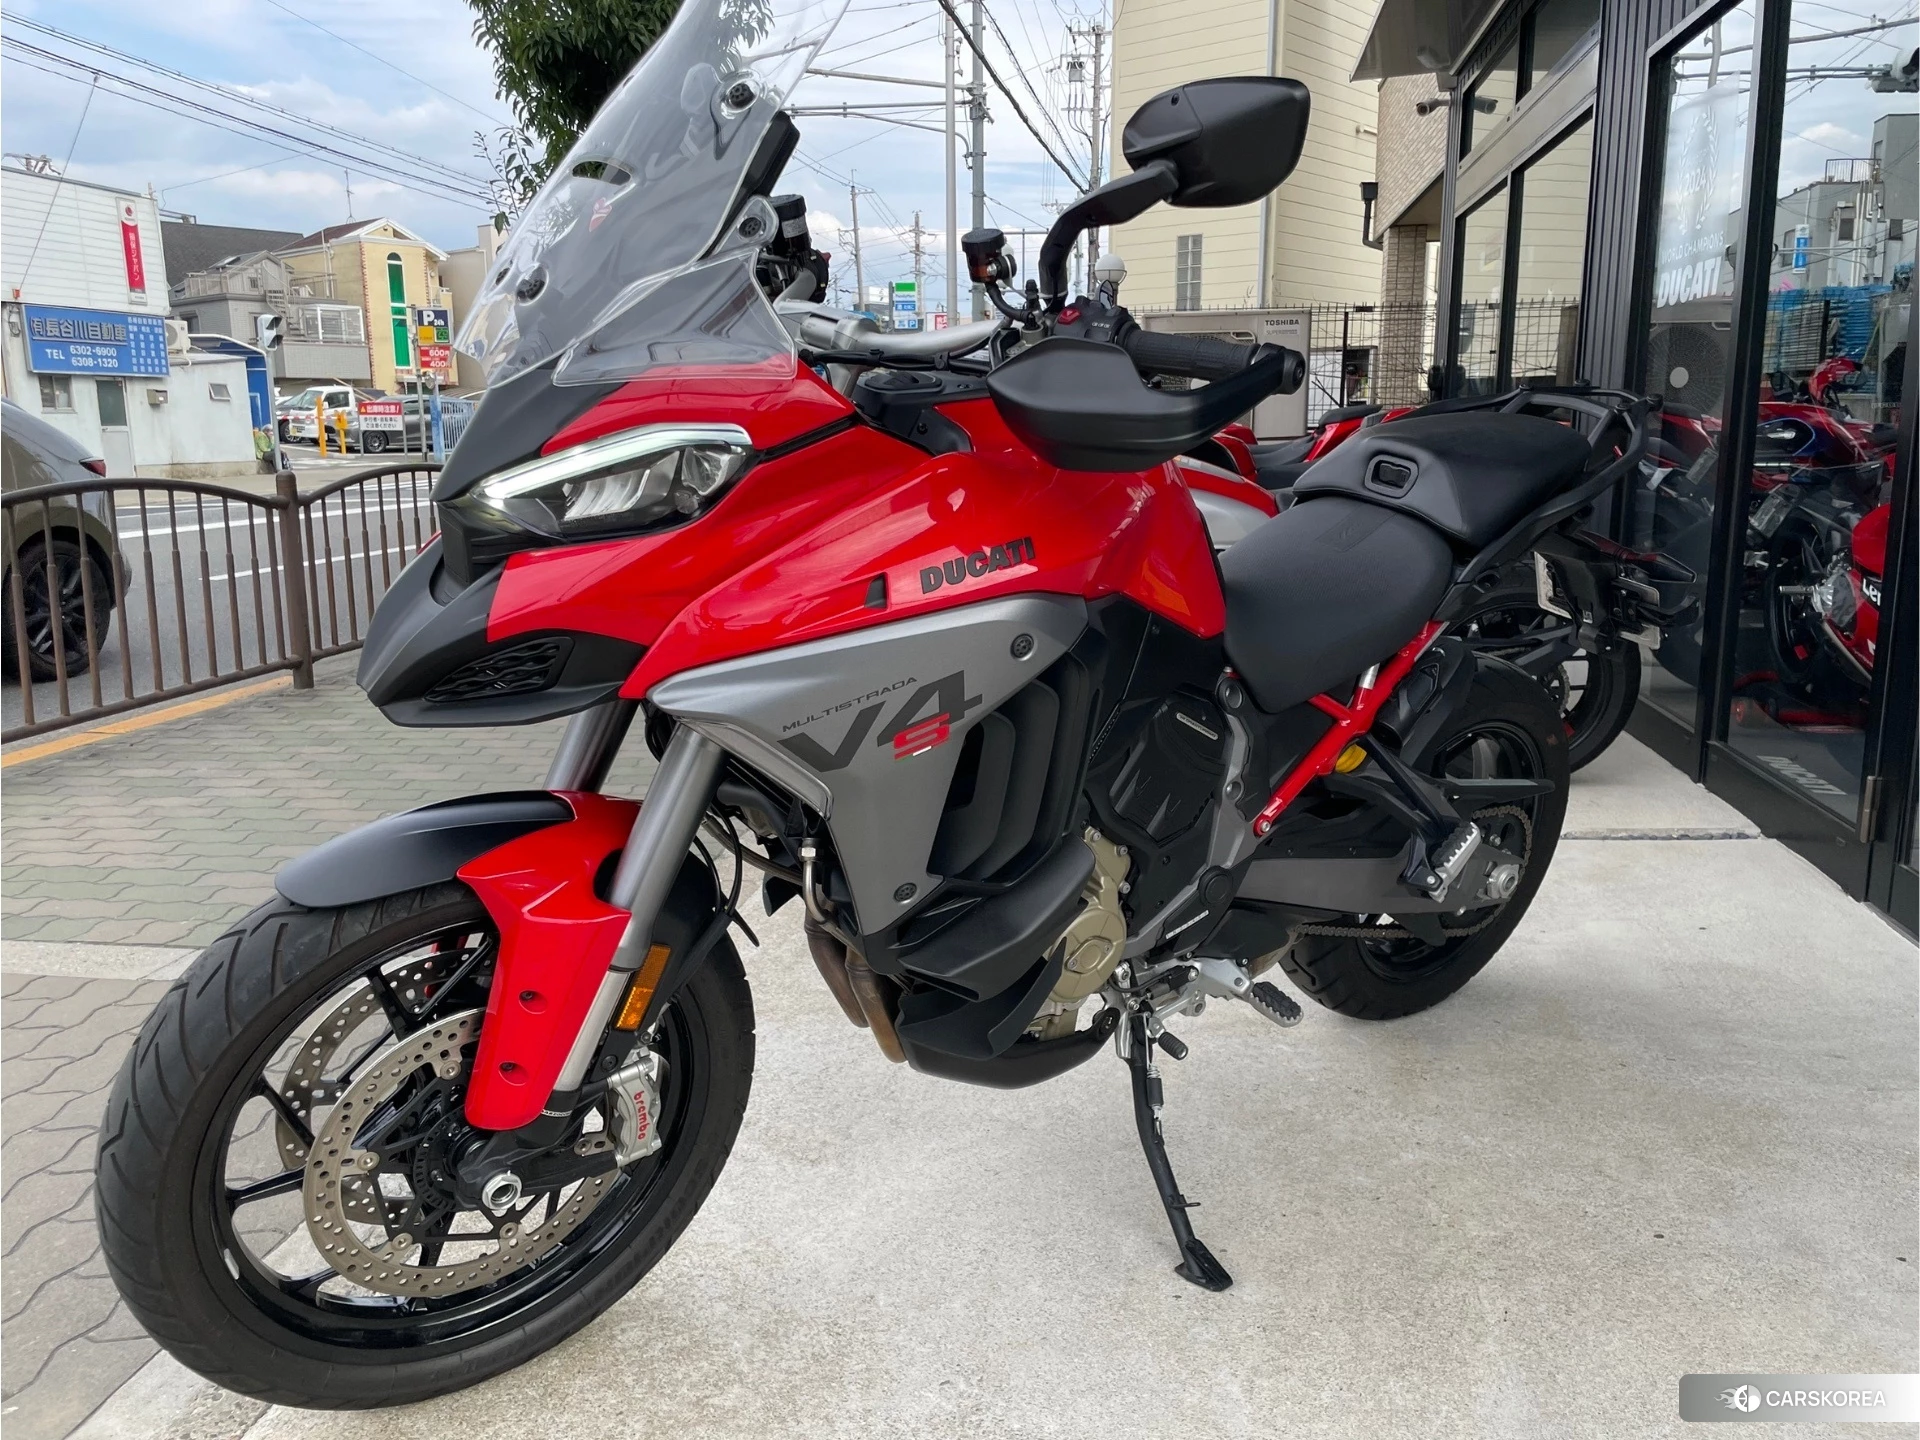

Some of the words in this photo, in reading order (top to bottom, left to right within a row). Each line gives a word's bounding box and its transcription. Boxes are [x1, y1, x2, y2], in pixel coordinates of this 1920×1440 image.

[1684, 166, 1707, 196] 2024
[1661, 245, 1683, 264] WORLD
[1683, 230, 1725, 259] CHAMPIONS
[1657, 256, 1722, 309] DUCATI
[423, 311, 435, 326] P
[46, 349, 65, 360] TEL
[919, 536, 1036, 595] DUCATI
[776, 669, 983, 773] V4
[782, 677, 918, 733] MULTISTRADA
[633, 1090, 650, 1140] brembo
